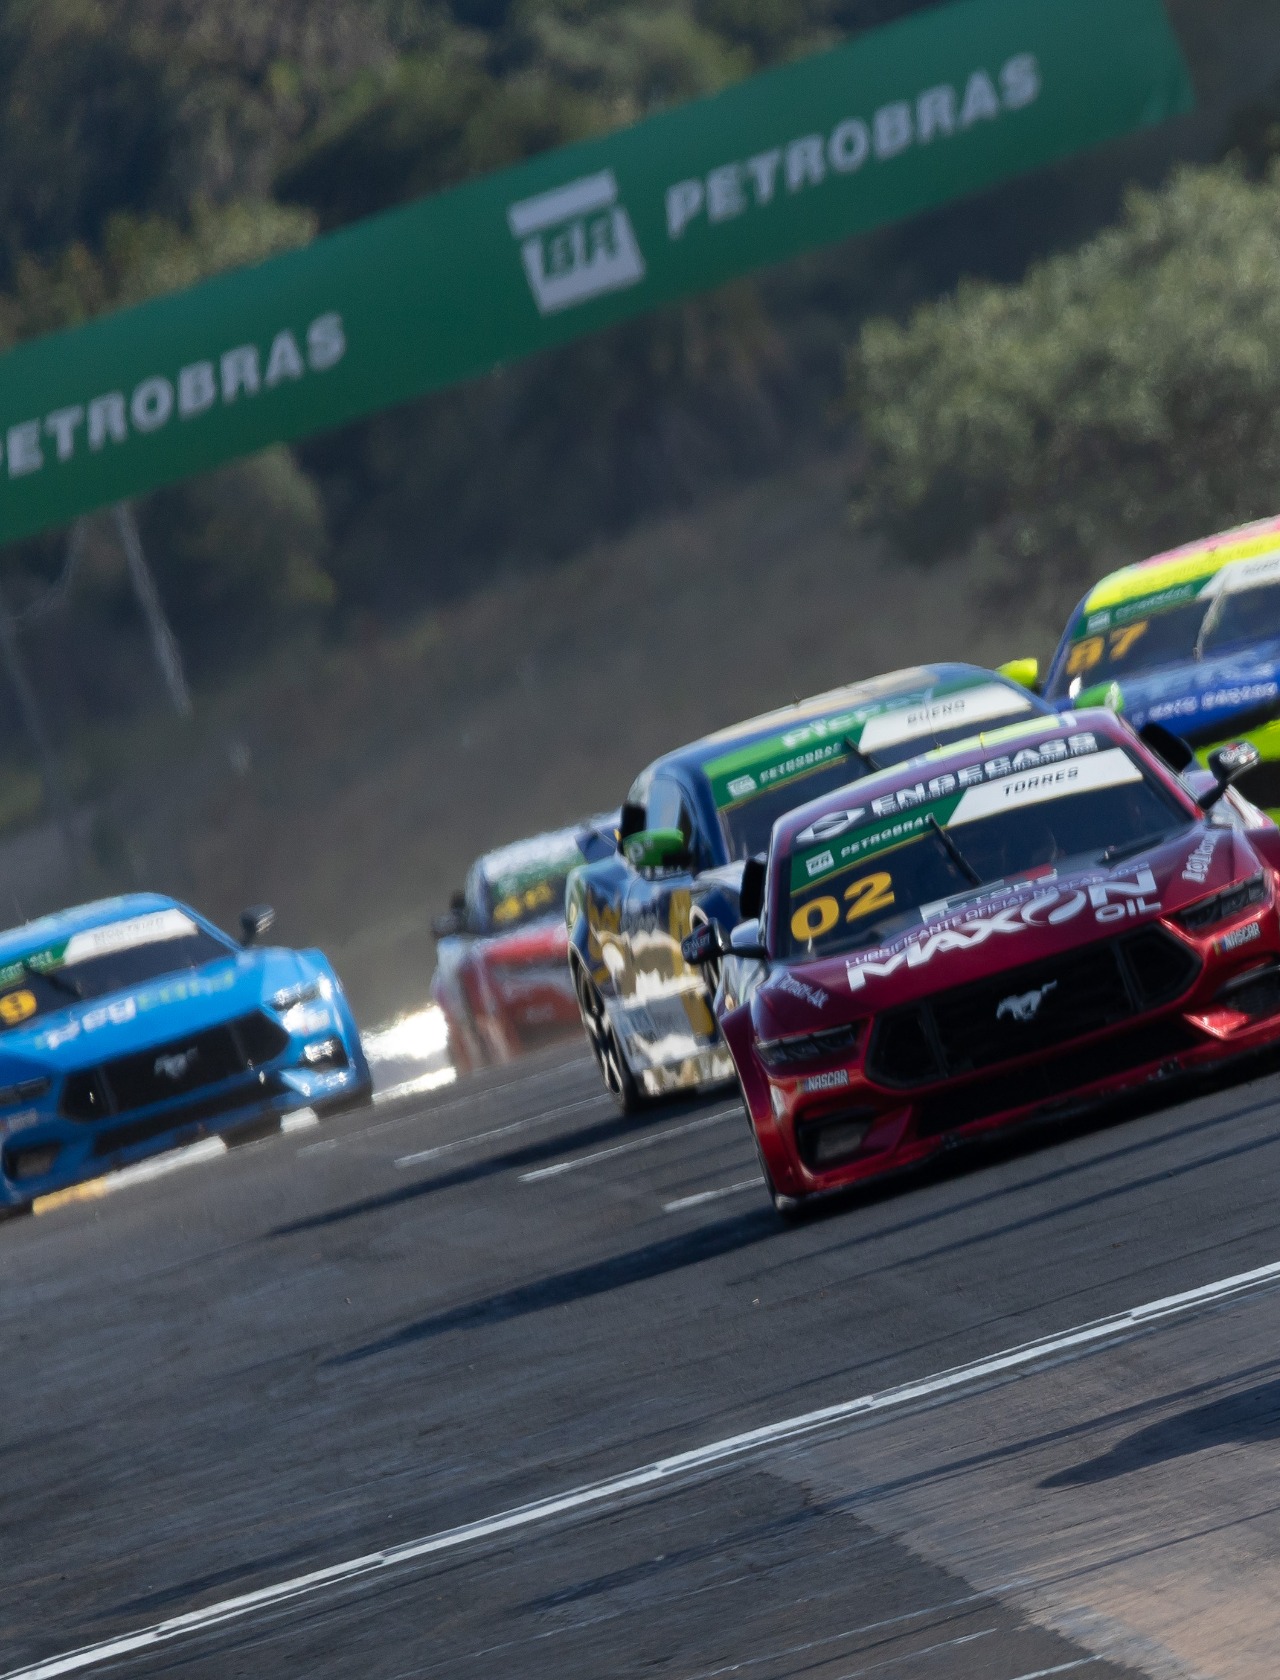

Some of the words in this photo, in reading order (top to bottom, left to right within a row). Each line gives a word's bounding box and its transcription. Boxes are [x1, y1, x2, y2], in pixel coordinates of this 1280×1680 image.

[666, 52, 1041, 241] PETROBRAS
[0, 312, 347, 478] ETROBRAS
[1002, 767, 1079, 796] TORRES
[790, 872, 895, 941] 02
[847, 868, 1157, 992] MAXON
[1095, 898, 1161, 923] OIL
[1223, 922, 1261, 950] NASCAR
[808, 1069, 848, 1090] NASCAR
